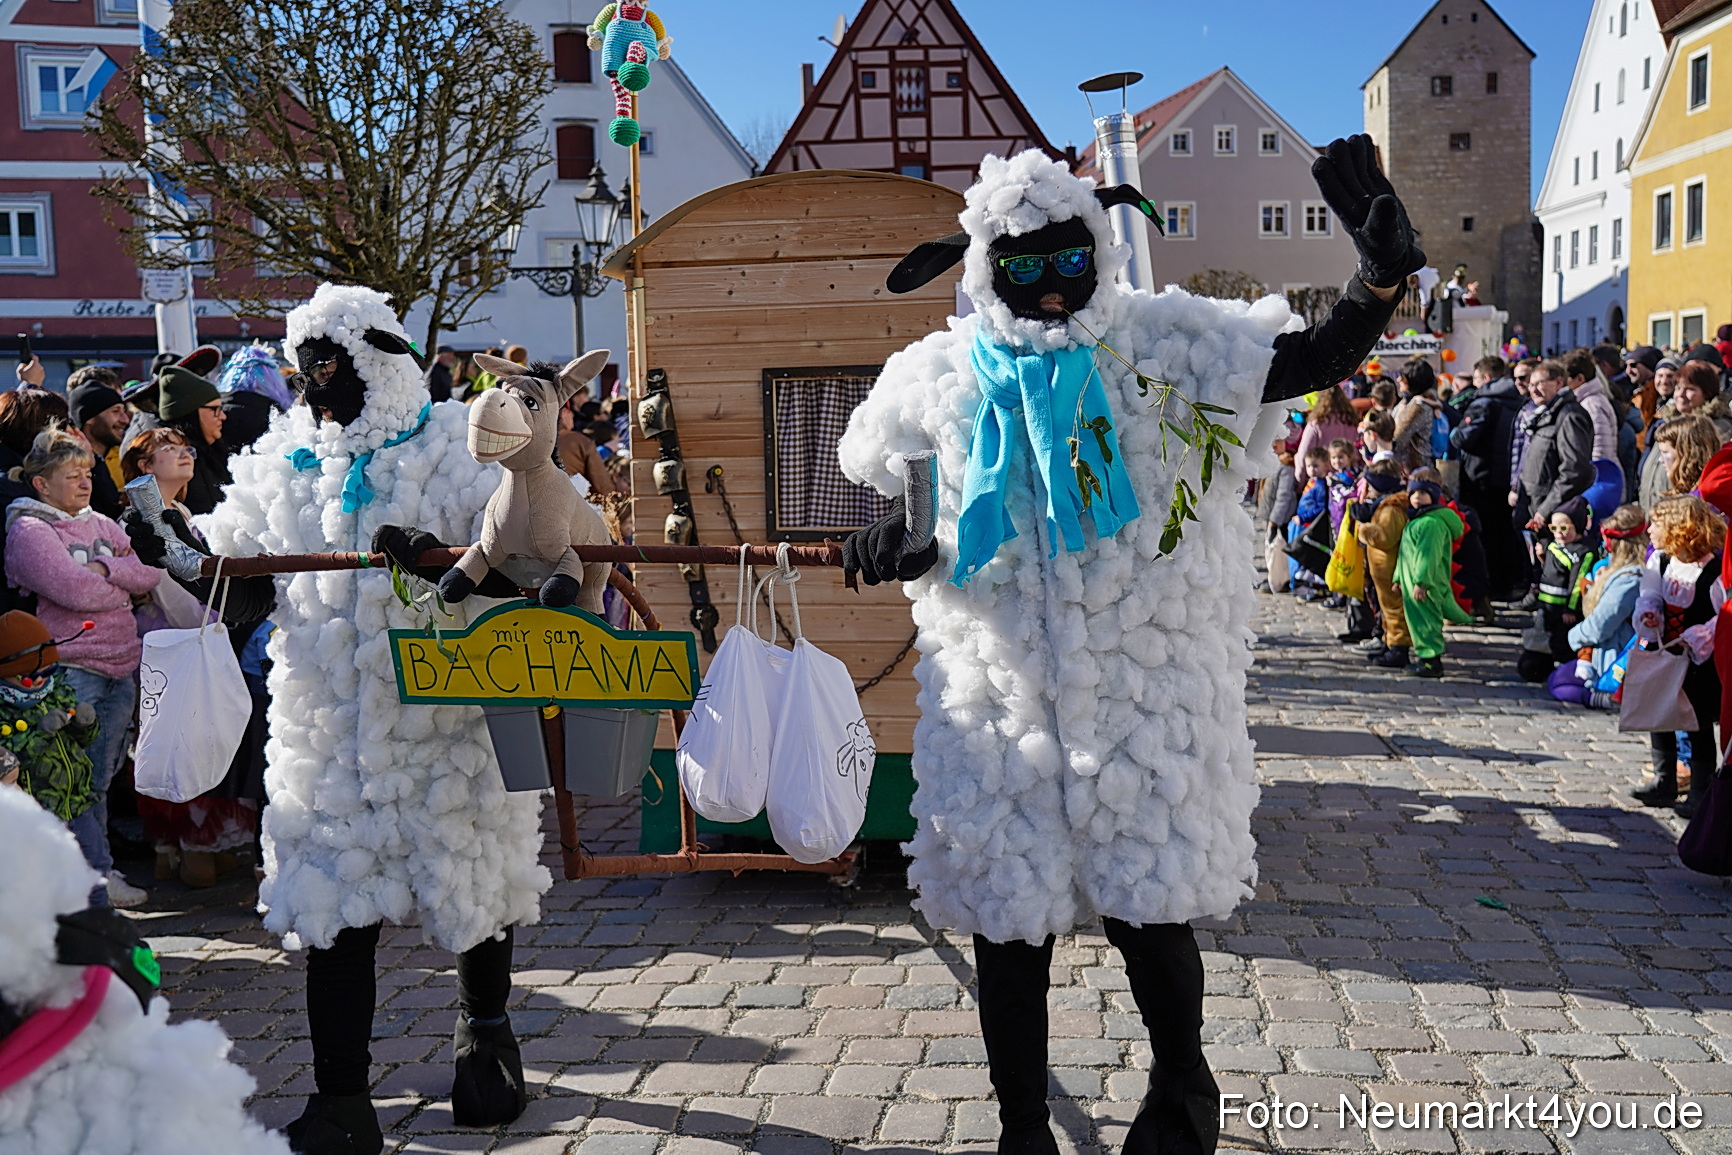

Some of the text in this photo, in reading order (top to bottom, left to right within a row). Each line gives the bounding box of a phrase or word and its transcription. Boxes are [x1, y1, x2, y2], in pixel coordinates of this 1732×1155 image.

[73, 299, 135, 315] Riebe
[1374, 339, 1442, 353] Berching
[492, 621, 585, 645] mir san
[408, 643, 691, 696] BACHAMA
